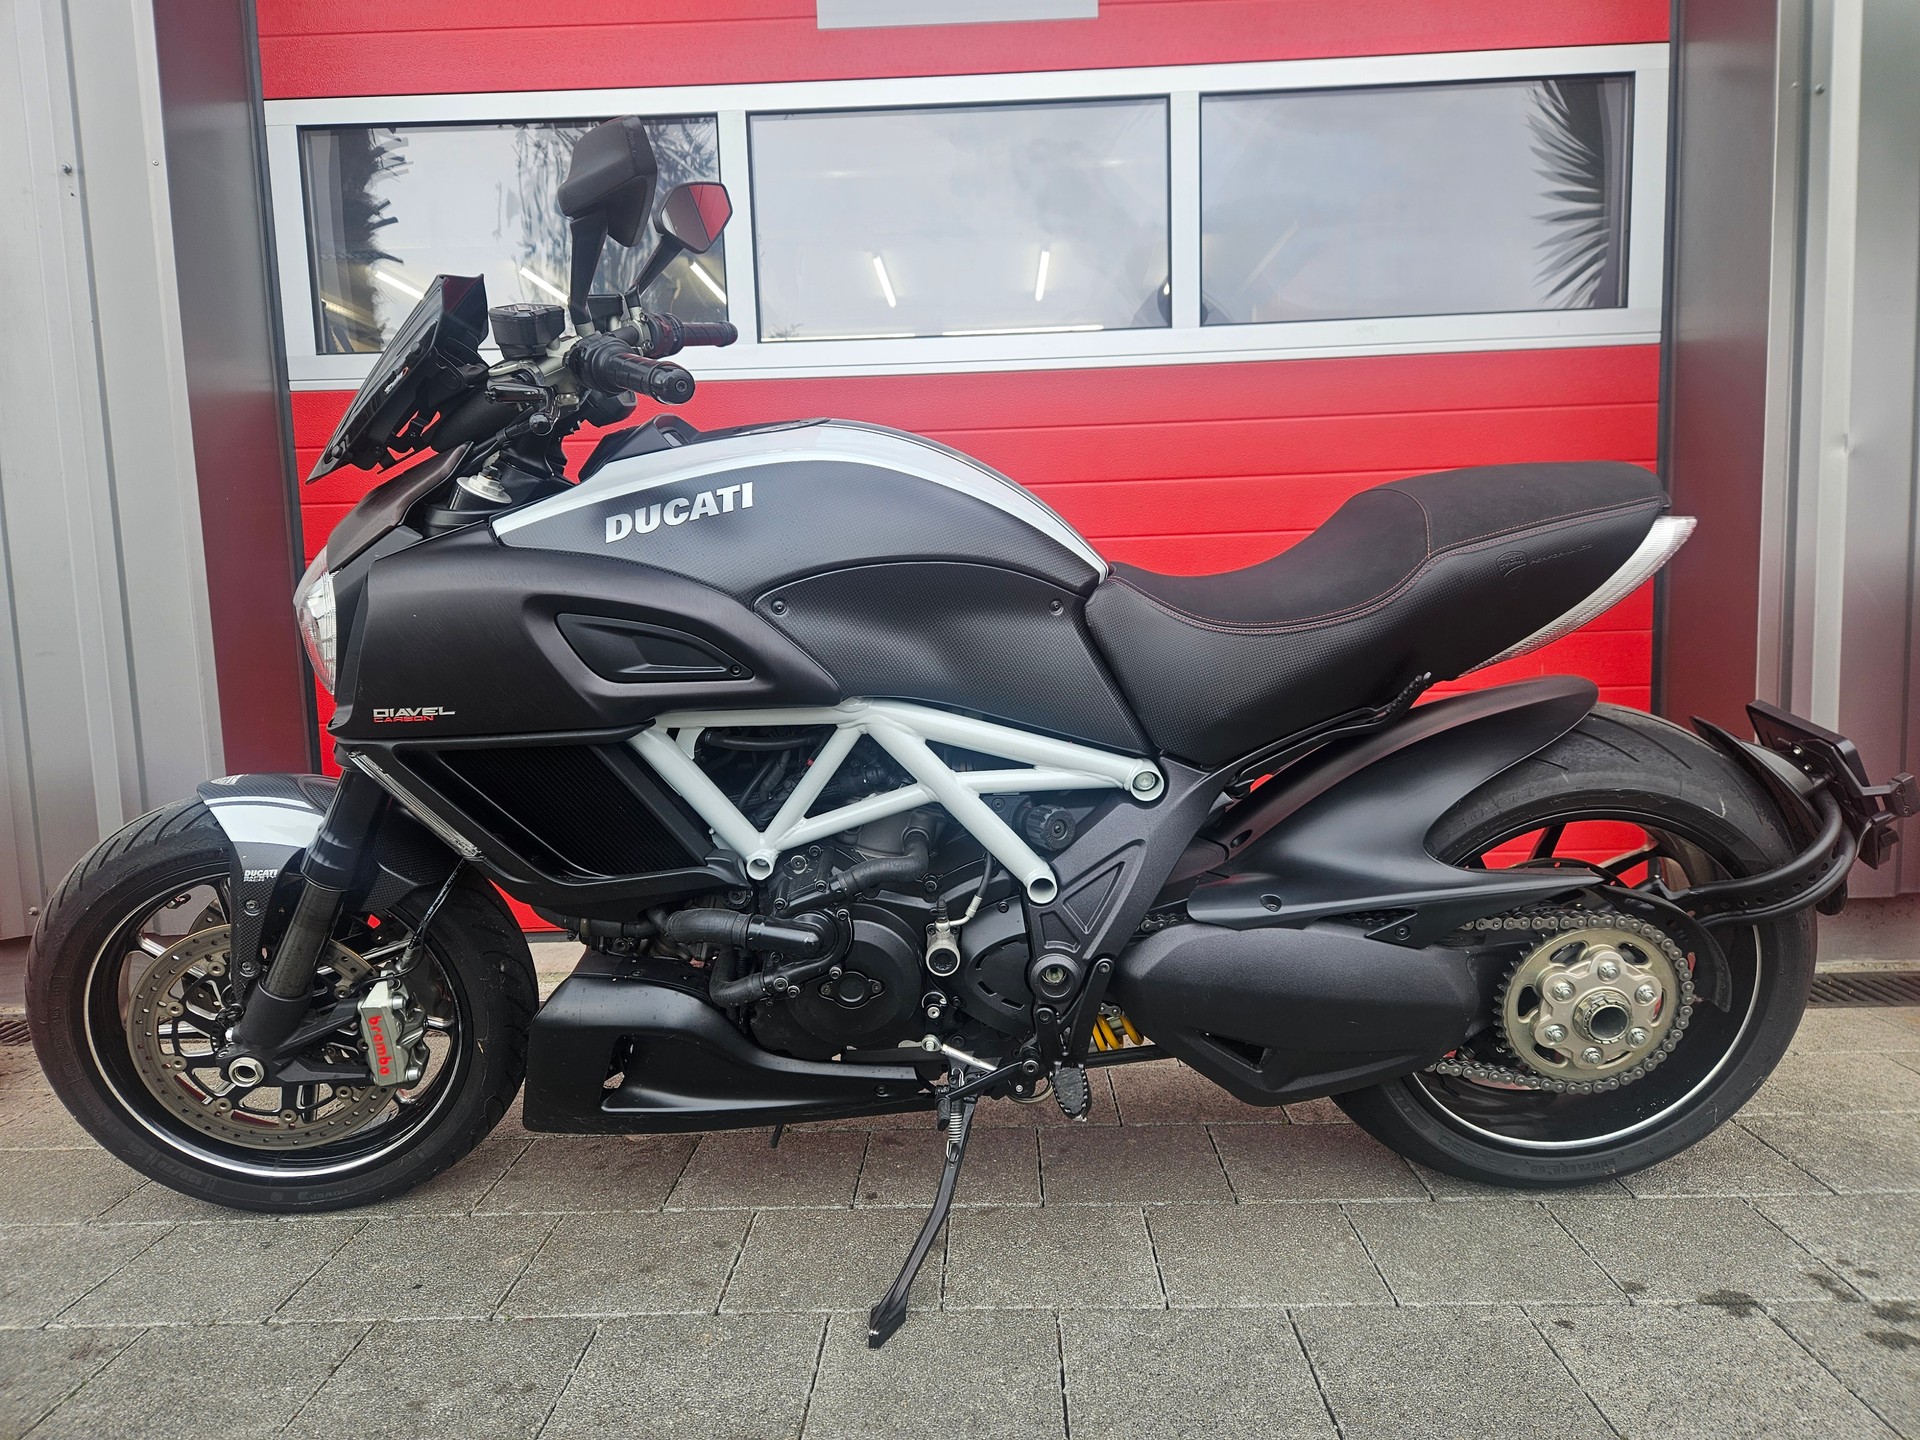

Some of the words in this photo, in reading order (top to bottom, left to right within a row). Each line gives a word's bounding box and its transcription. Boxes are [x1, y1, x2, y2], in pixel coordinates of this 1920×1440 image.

[605, 481, 753, 544] DUCATI
[373, 706, 456, 717] DIAVEL
[373, 715, 434, 723] CARBON
[244, 869, 278, 877] DUCATI
[368, 1016, 392, 1076] brembo
